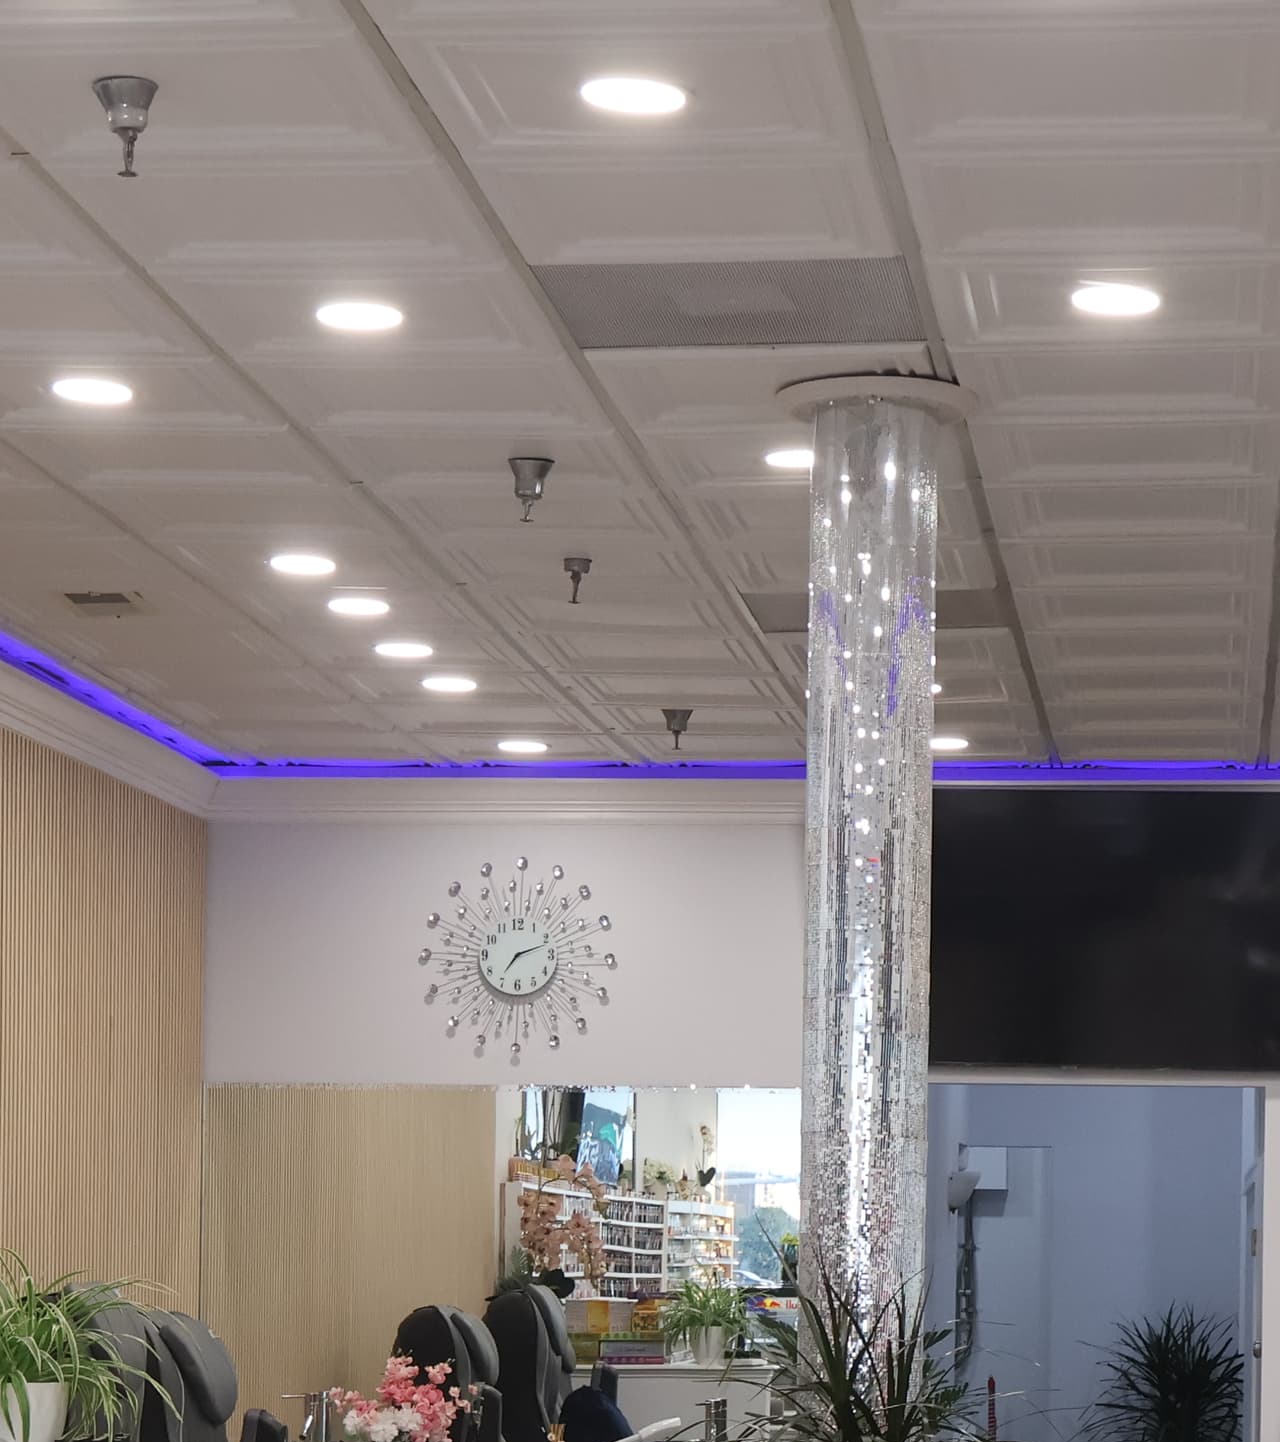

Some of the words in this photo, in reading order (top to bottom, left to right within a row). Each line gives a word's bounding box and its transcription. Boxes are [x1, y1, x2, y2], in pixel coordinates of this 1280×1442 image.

[497, 923, 506, 933] 11
[512, 918, 524, 931] 12
[532, 922, 536, 933] 1
[486, 934, 497, 945] 10
[543, 933, 549, 944] 2
[481, 949, 488, 961] 9
[548, 949, 555, 961] 3
[487, 966, 493, 976] 8
[542, 966, 548, 977] 4
[499, 977, 505, 989] 7
[514, 979, 521, 992] 6
[530, 976, 537, 988] 5
